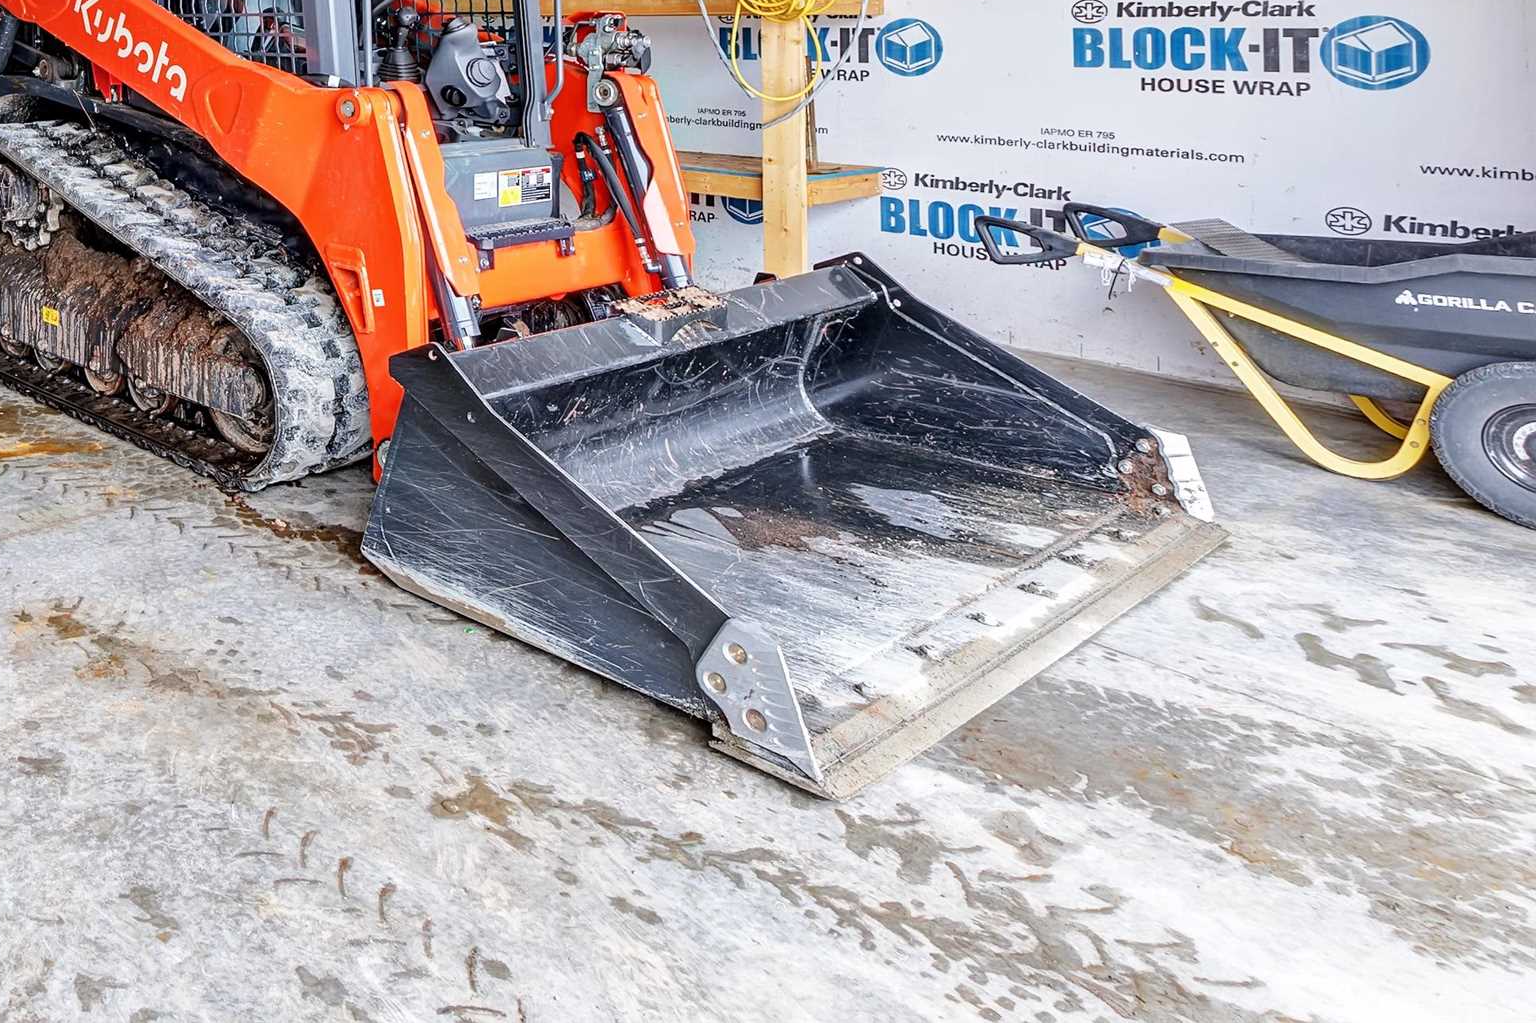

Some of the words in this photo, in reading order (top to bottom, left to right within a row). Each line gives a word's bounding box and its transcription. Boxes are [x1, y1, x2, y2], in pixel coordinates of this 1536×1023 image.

[1116, 0, 1316, 22] Kimberly-Clark
[718, 27, 875, 64] BLK-IT
[1072, 25, 1321, 74] BLOCK-IT
[1140, 76, 1226, 95] HOUSE
[1232, 79, 1312, 98] WRAP
[1040, 127, 1075, 138] IAPMO
[1077, 129, 1093, 138] ER
[1095, 131, 1116, 140] 795
[936, 133, 1245, 164] www.kimberly-clarkbuildingmaterials.com
[914, 172, 1072, 202] Kimberly-Clark
[688, 209, 716, 224] RAP
[880, 195, 1068, 248] BLOCKIT
[1383, 214, 1524, 241] Kimberl
[933, 241, 990, 261] HOUS
[1416, 293, 1513, 313] GORILLA
[1517, 301, 1536, 314] C
